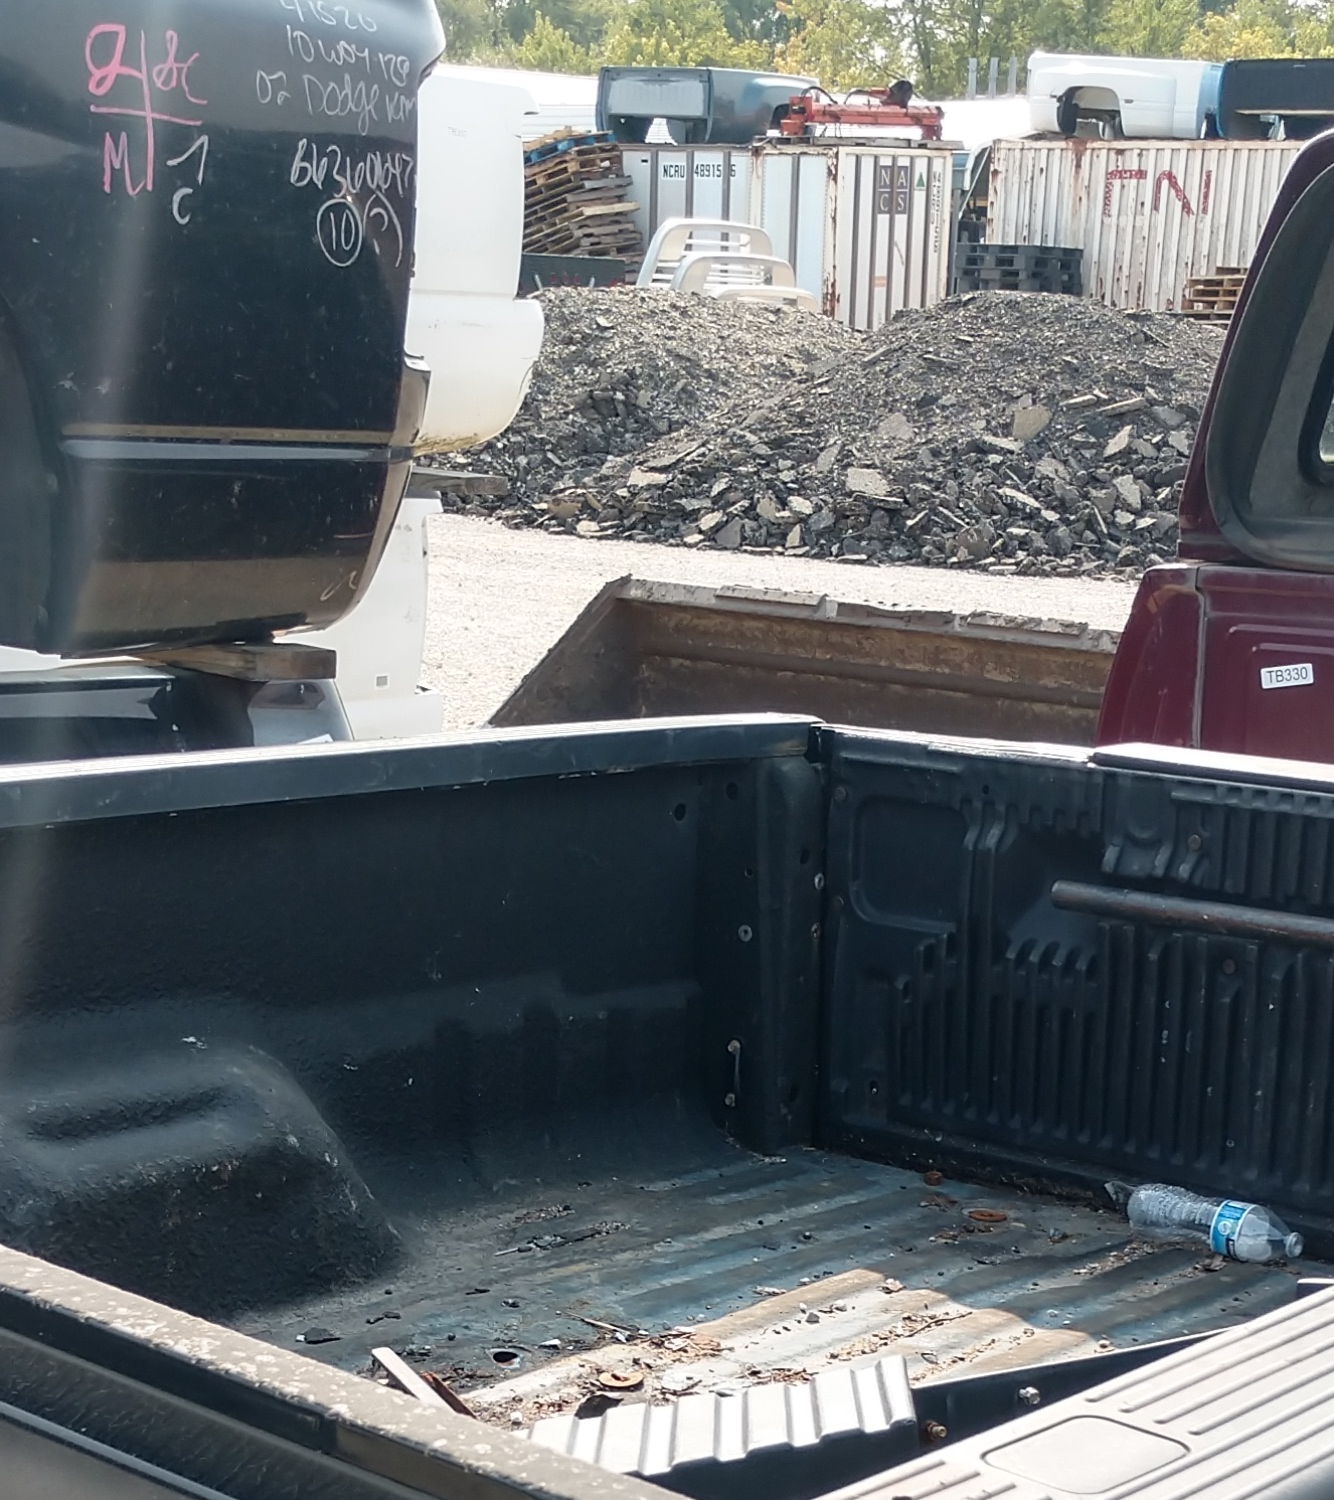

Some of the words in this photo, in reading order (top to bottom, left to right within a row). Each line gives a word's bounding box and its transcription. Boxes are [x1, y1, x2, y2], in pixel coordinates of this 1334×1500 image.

[303, 73, 379, 136] Dodge
[663, 164, 685, 178] NCRU
[1266, 666, 1308, 684] TB330
